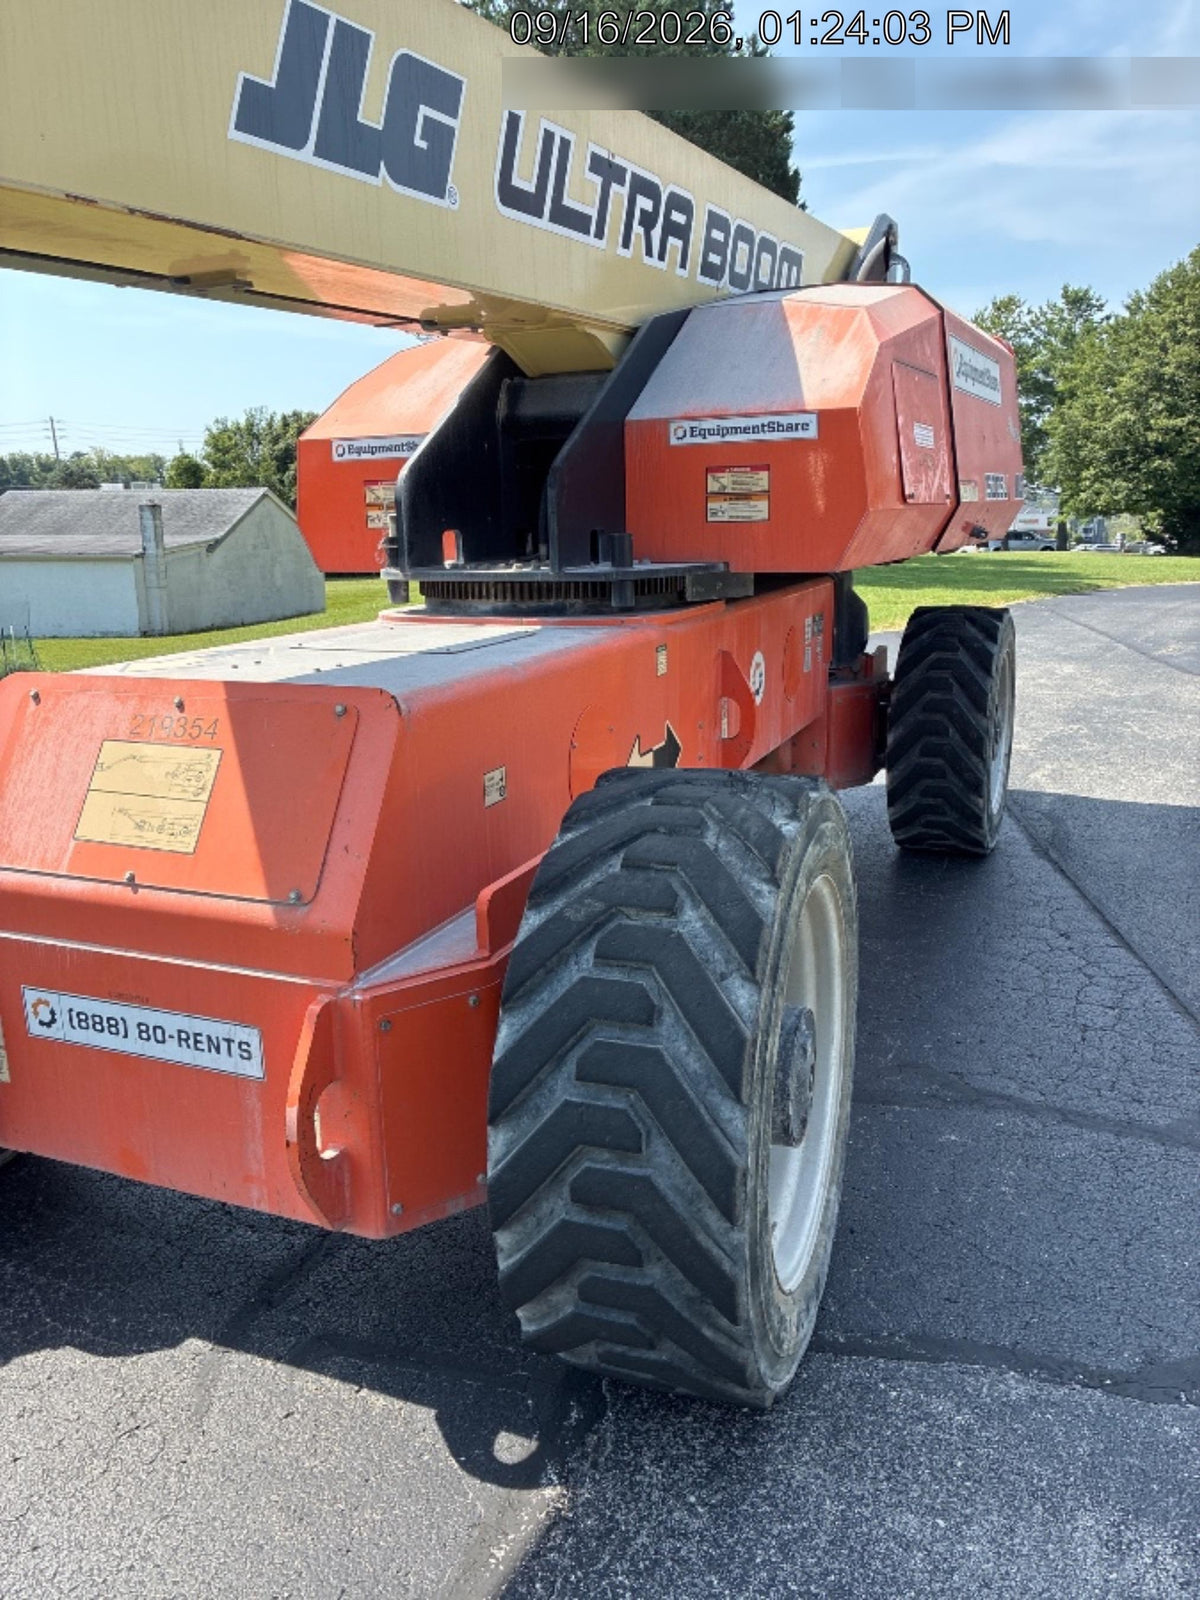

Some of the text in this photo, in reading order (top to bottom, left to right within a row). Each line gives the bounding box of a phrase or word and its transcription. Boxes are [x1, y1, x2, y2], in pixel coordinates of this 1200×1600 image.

[229, 0, 466, 206] JLG
[496, 110, 804, 292] ULTRA BOOM
[689, 421, 810, 440] EquipmentShare
[129, 714, 219, 740] 219354
[68, 1007, 254, 1061] (888) 80-RENTS
